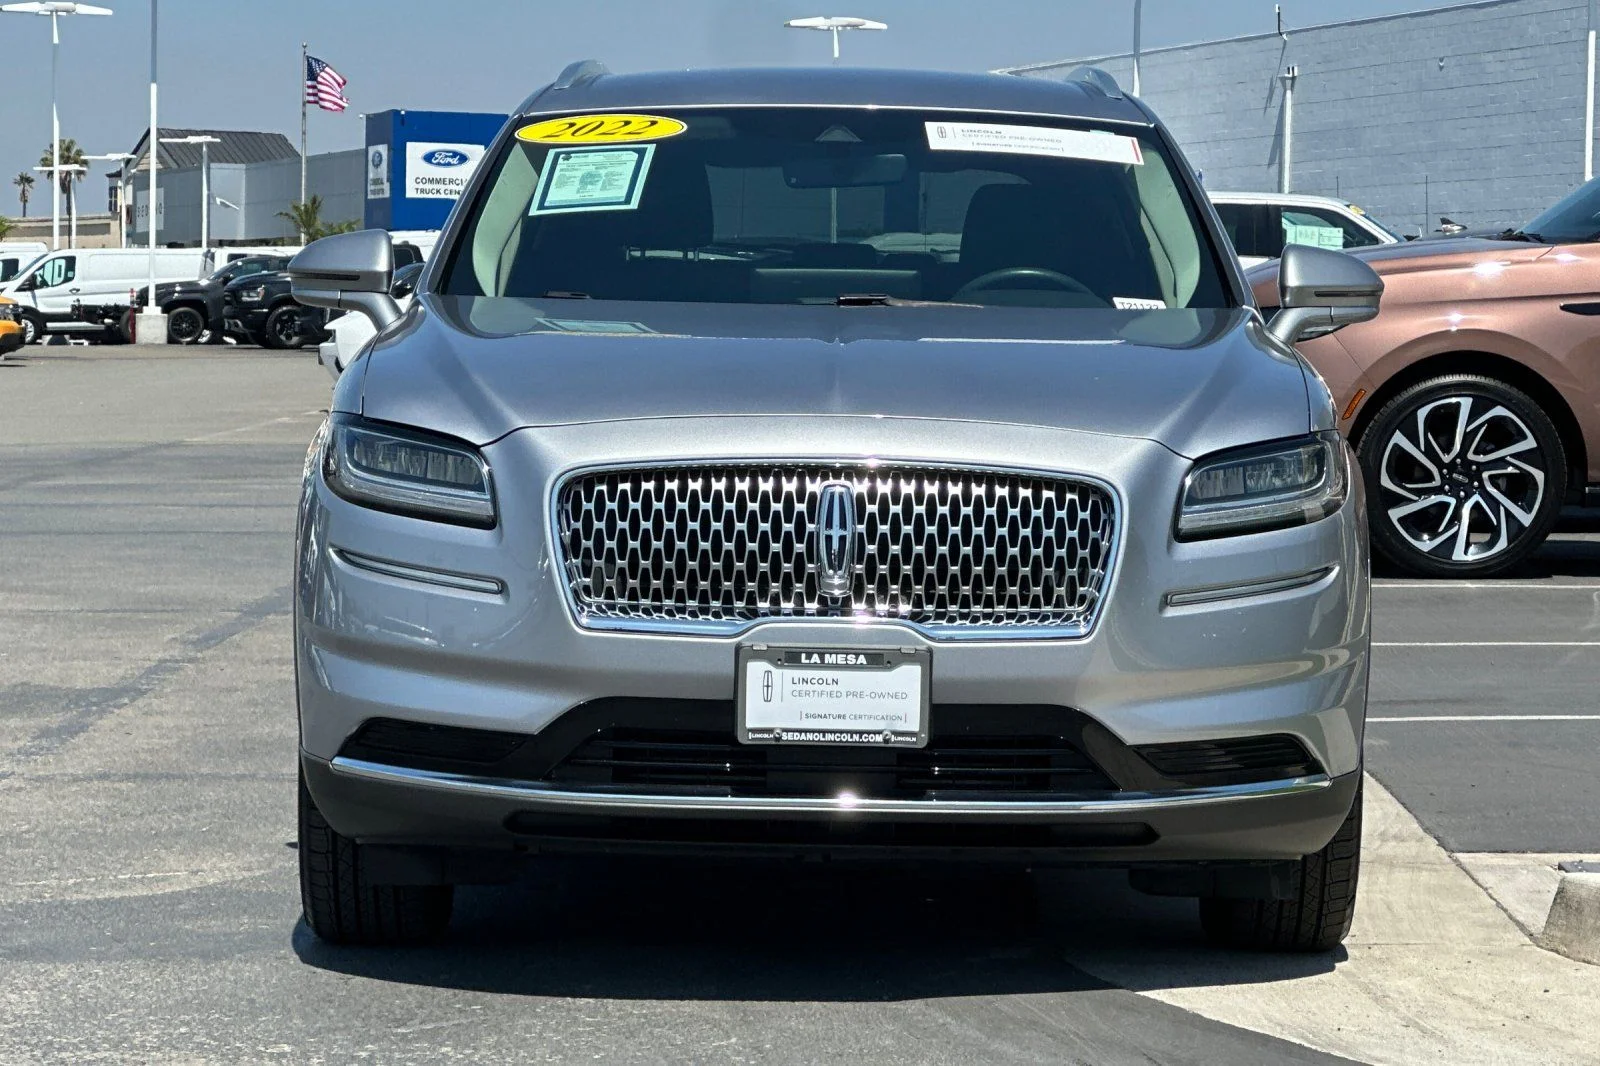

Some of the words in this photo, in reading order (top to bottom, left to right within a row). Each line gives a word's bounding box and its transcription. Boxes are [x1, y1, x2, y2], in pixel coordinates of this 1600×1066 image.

[541, 120, 659, 139] 2022
[431, 151, 461, 165] Ford
[414, 176, 467, 186] COMMERCI
[414, 187, 442, 195] TRUCK
[801, 653, 821, 664] LA
[824, 653, 868, 665] MESA
[791, 676, 839, 686] LINCOLN
[791, 689, 843, 699] CERTIFIED
[845, 690, 908, 700] PRE-OWNED
[804, 712, 847, 720] SIGNATURE
[848, 713, 903, 722] CERTIFICATION
[781, 731, 884, 743] SEDANOLINCOLN.COM
[894, 735, 917, 743] LINCOLN
